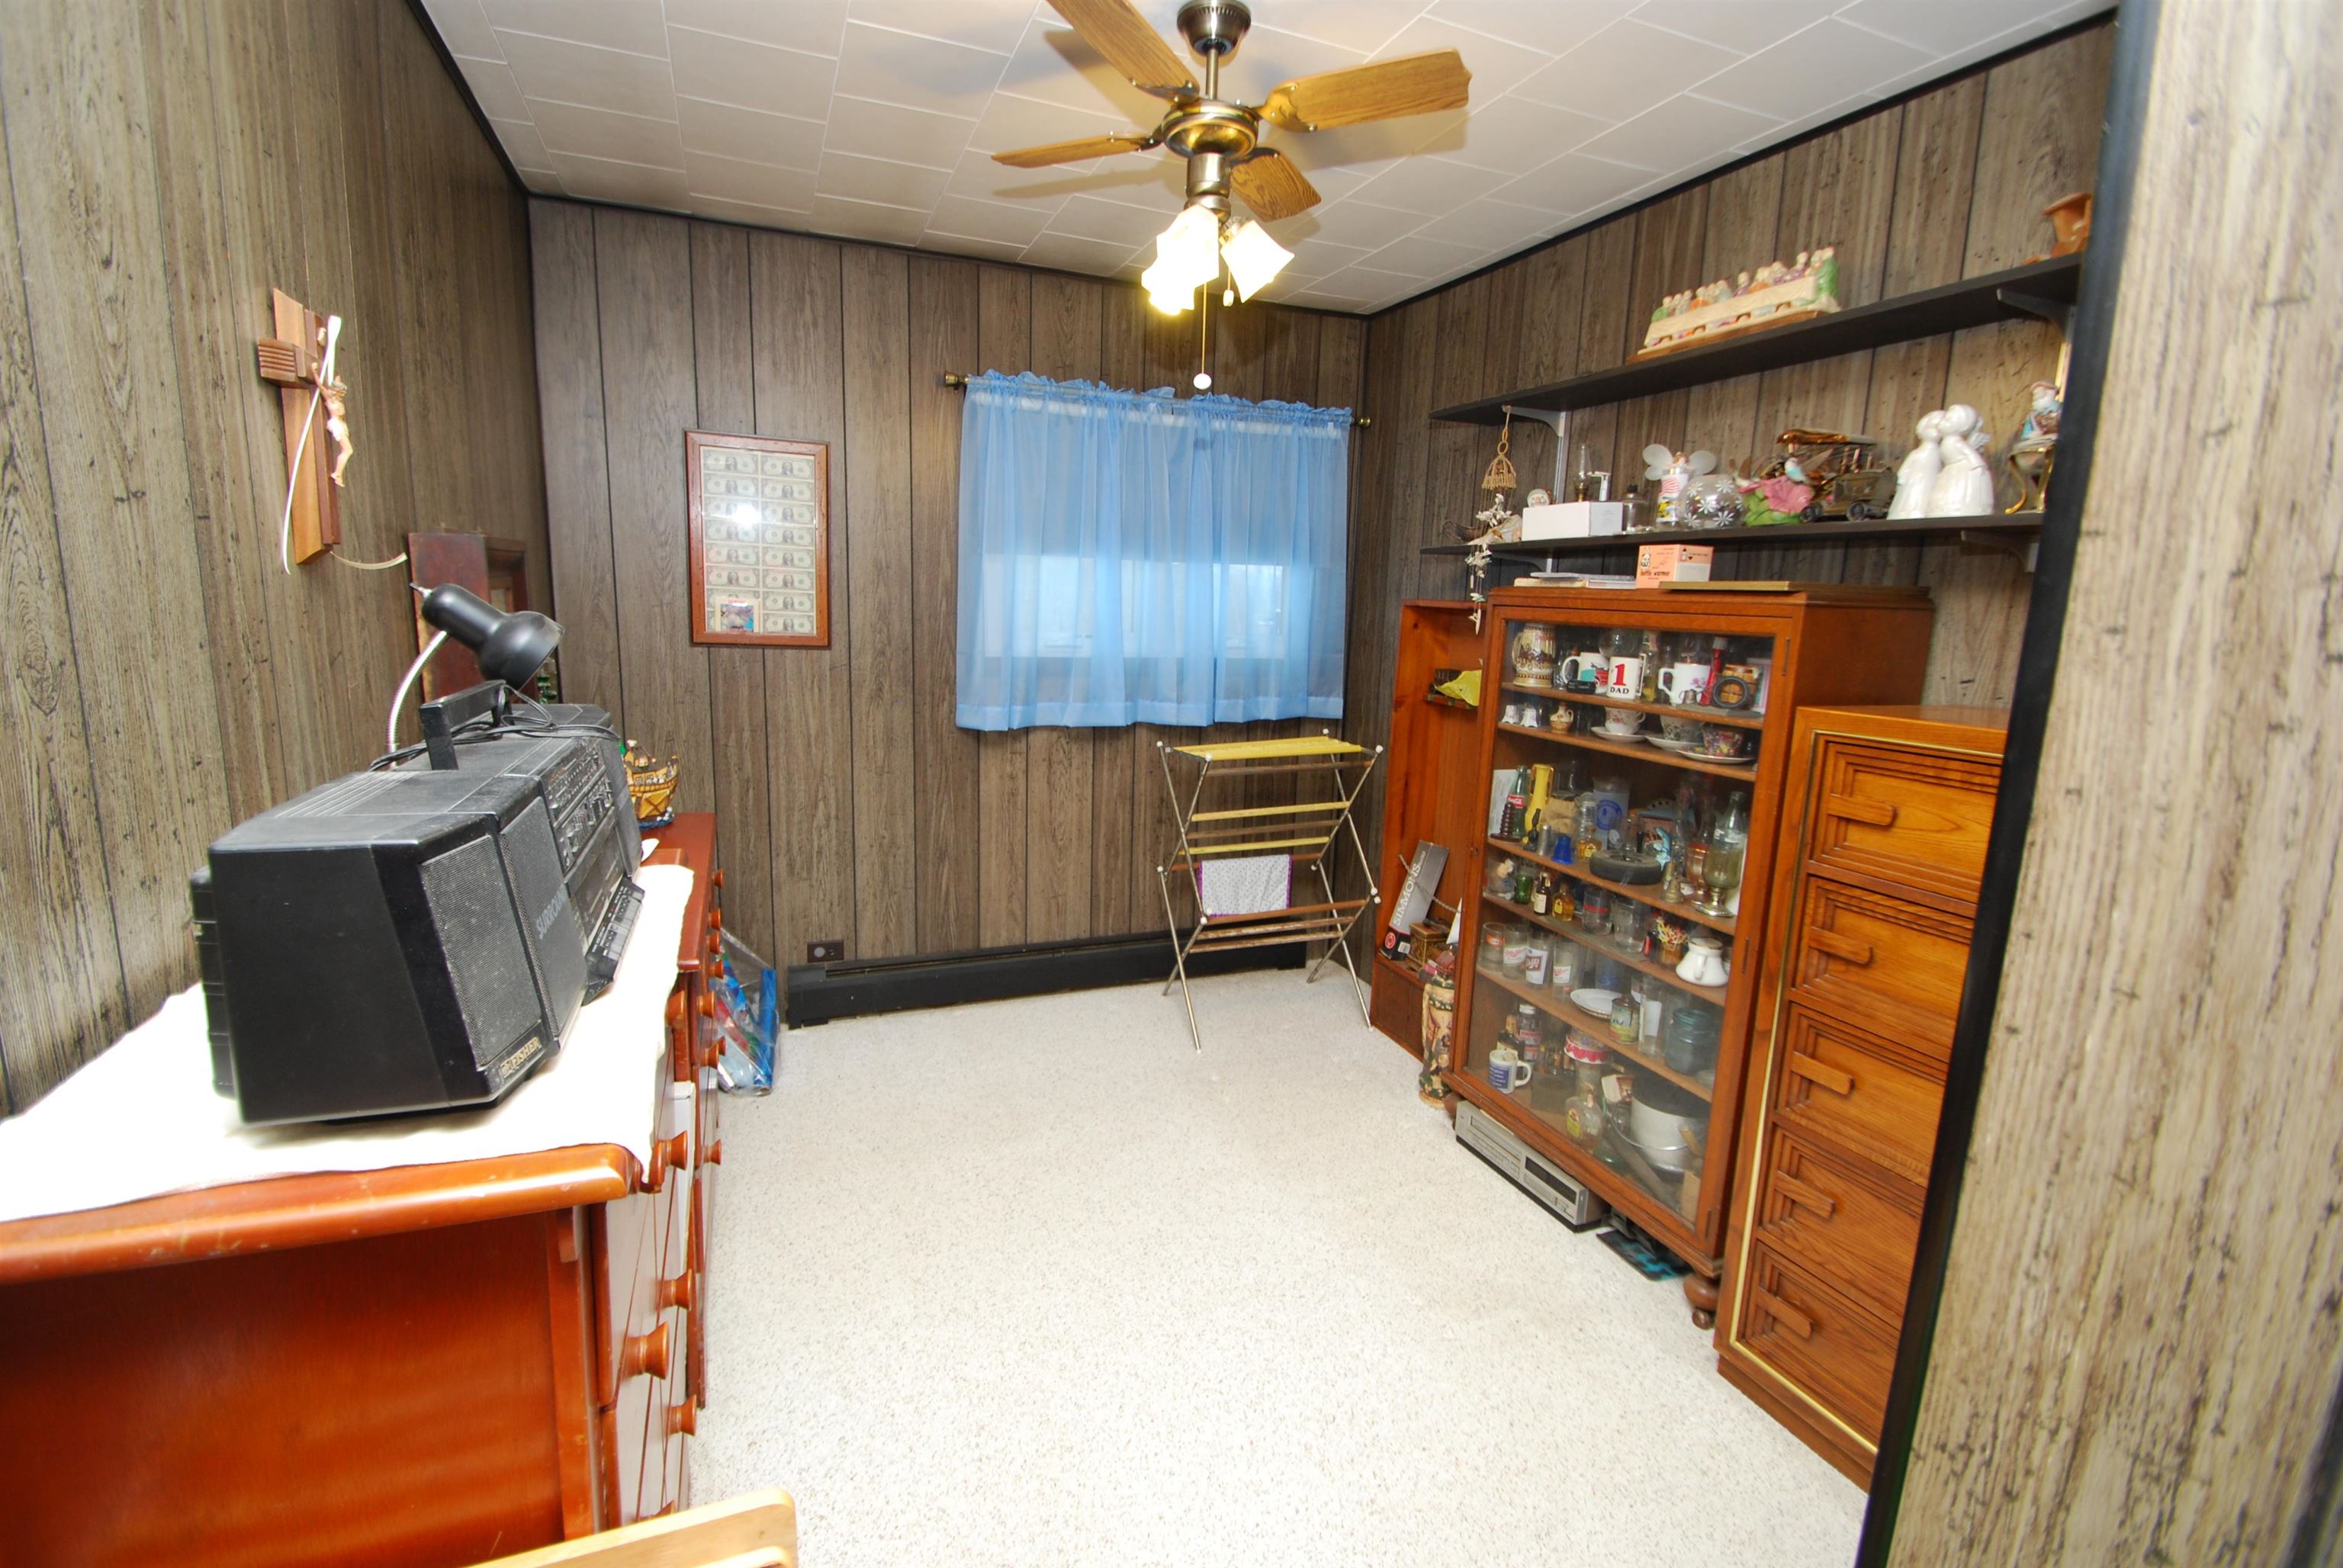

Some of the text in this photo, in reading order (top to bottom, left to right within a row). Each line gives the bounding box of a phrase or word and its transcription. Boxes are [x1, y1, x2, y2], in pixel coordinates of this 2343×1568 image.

[1610, 686, 1629, 695] DAD
[1393, 863, 1421, 927] SIMMONS
[512, 1037, 541, 1068] FISHER
